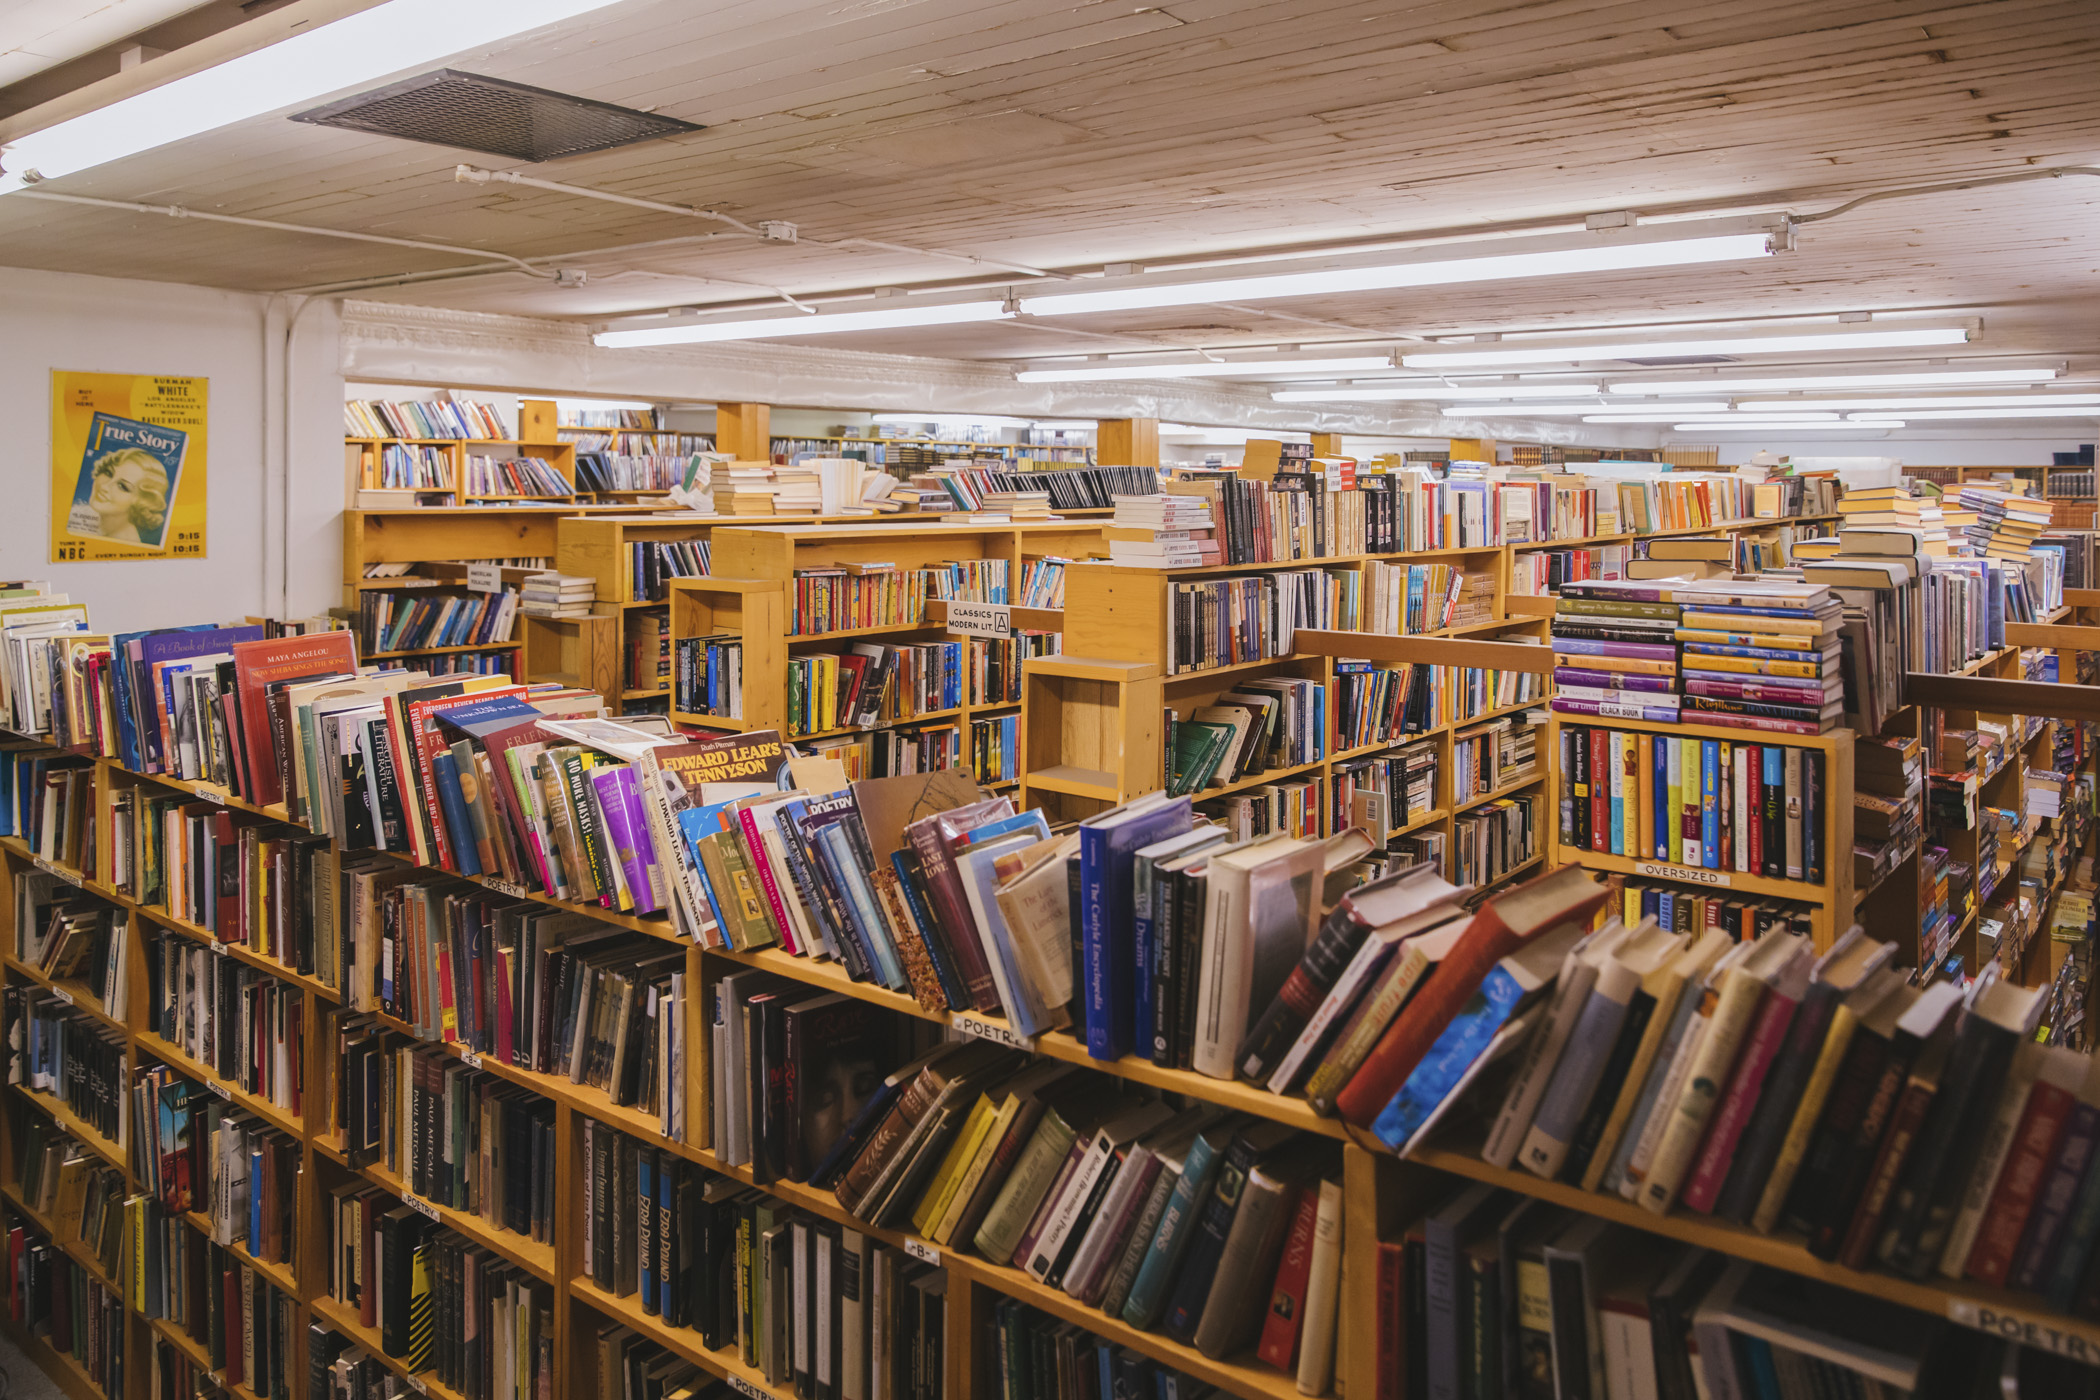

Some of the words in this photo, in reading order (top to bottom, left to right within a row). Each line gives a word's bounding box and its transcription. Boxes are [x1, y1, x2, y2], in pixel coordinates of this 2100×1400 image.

[158, 386, 188, 396] WHITE
[94, 420, 134, 450] True
[137, 430, 180, 456] Story
[59, 548, 85, 560] NBC
[948, 620, 979, 629] MODERN
[981, 622, 994, 631] LIT.
[954, 609, 992, 619] CLASSICS
[996, 615, 1008, 632] A
[1561, 626, 1596, 636] JEZEBEL
[169, 640, 194, 653] Book
[196, 638, 206, 654] of
[267, 653, 290, 664] MAYA
[292, 648, 329, 658] ANGELOU
[1748, 649, 1770, 658] Shelby
[251, 669, 268, 678] NOW
[292, 664, 312, 672] SINGS
[328, 658, 347, 667] SONG
[452, 706, 506, 718] UNKNOWN
[1601, 705, 1620, 715] BLACK
[1622, 707, 1639, 717] BOOK
[278, 717, 287, 757] AMERICAN
[700, 743, 715, 751] Ruth
[715, 741, 736, 749] Pitman
[380, 733, 394, 784] ENGLISH
[409, 707, 425, 746] EVERGREEN
[417, 748, 428, 773] REVIEW
[423, 774, 433, 800] READER
[645, 751, 656, 769] Ruth
[662, 750, 729, 772] EDWARD
[730, 742, 782, 762] LEAR'S
[282, 760, 290, 792] WRITERS
[374, 735, 389, 801] LITERATURE
[684, 759, 768, 784] TENNYSON
[584, 783, 593, 802] DOUBLE
[649, 769, 663, 795] Pitman
[200, 790, 220, 802] POETRY
[567, 759, 581, 773] NO
[576, 800, 593, 834] MASKS!
[810, 796, 854, 814] POETRY
[1766, 801, 1776, 819] Wife
[778, 813, 793, 840] POETRY
[584, 834, 597, 868] FLORENCE
[789, 840, 798, 850] OF
[793, 850, 803, 864] THE
[658, 797, 676, 838] EDWARD
[671, 839, 686, 872] LEAR'S
[681, 874, 701, 926] TENNYSON
[741, 810, 750, 823] KIM
[746, 824, 763, 860] ADDONIZIO
[761, 867, 779, 905] ORDINARY
[774, 906, 789, 934] GENIUS
[921, 853, 942, 868] LAST
[924, 862, 948, 879] LOVE
[601, 857, 613, 887] NICHOLSON
[609, 888, 617, 905] BAKER
[738, 836, 754, 866] Classics
[752, 874, 778, 930] Christmastime
[799, 863, 814, 889] WORLD
[1646, 865, 1718, 883] OVERSIZED
[487, 879, 518, 895] POETRY
[1090, 882, 1099, 901] The
[810, 889, 824, 912] WARS
[835, 897, 848, 918] Word
[843, 918, 854, 931] the
[1089, 904, 1100, 941] Carlyle
[1163, 902, 1171, 946] BREAKING
[852, 940, 871, 972] Pleasure
[1133, 921, 1146, 967] Dreams
[1163, 950, 1171, 976] POINT
[1091, 943, 1102, 1009] Encyclopedia
[210, 1081, 229, 1098] POETRY
[1082, 1153, 1102, 1182] Robert
[584, 1182, 590, 1191] of
[407, 1195, 434, 1218] POETRY
[640, 1195, 650, 1225] EZRA
[1060, 1178, 1089, 1221] Browning's
[660, 1206, 670, 1236] EZRA
[740, 1217, 749, 1239] EZRA
[1047, 1218, 1067, 1246] Poetry
[1153, 1205, 1182, 1253] BURNS
[640, 1227, 650, 1269] POUND
[1286, 1201, 1314, 1270] BURNS
[660, 1239, 670, 1281] POUND
[741, 1239, 750, 1266] POUND
[911, 1244, 932, 1260] -B-
[243, 1270, 251, 1312] ROBERT
[244, 1316, 252, 1359] LOWELL
